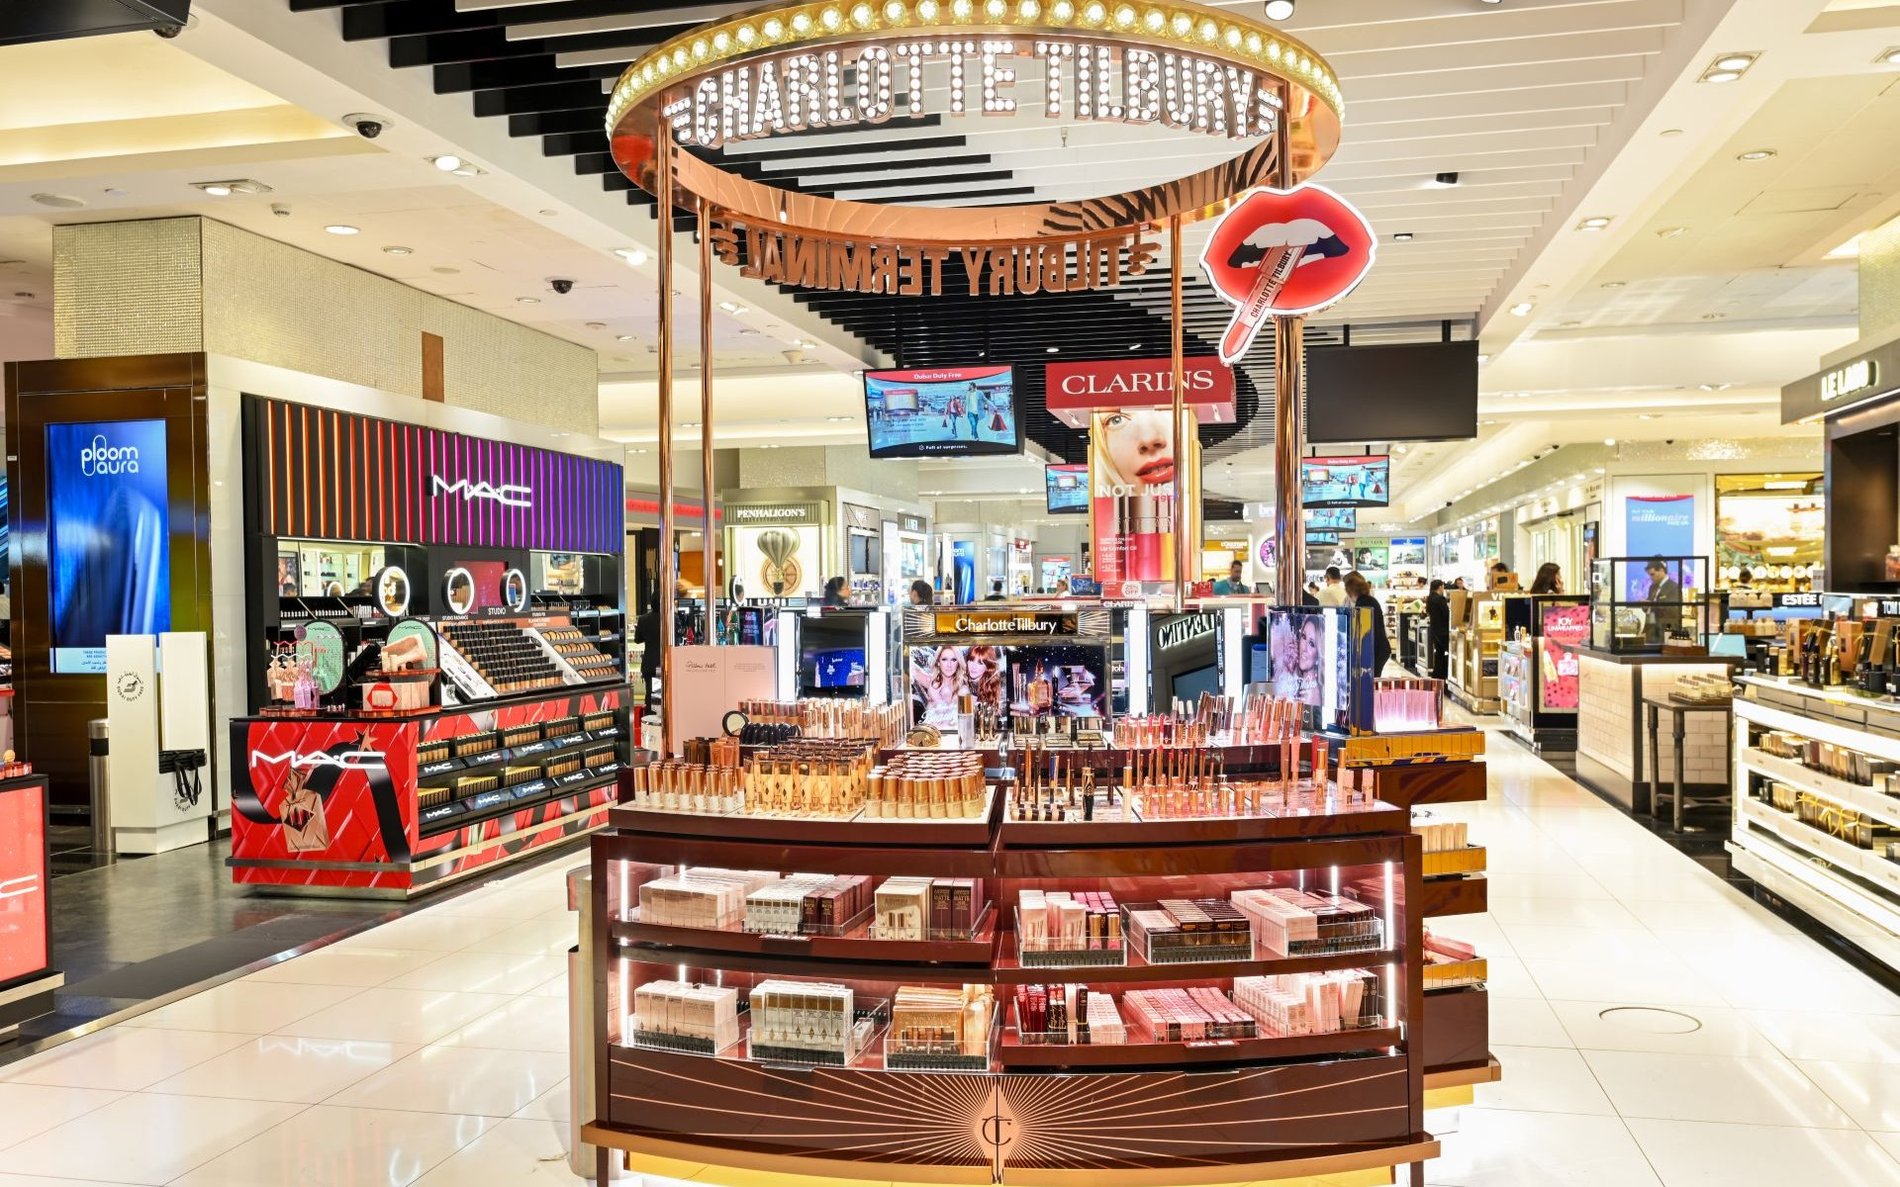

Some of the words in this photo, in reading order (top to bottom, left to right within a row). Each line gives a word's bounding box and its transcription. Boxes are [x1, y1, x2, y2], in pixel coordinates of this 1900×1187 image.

[696, 40, 1016, 150] CHARLOTTE
[1034, 40, 1254, 141] TILBURY
[1250, 278, 1277, 319] CHARLOTTE
[1271, 250, 1293, 280] TILBURY
[1062, 369, 1214, 395] CLARINS
[96, 461, 139, 475] aura
[1100, 484, 1136, 498] NOT
[737, 508, 806, 519] PENHALIGON'S
[488, 607, 507, 616] STUDIO
[1558, 617, 1573, 626] JOY
